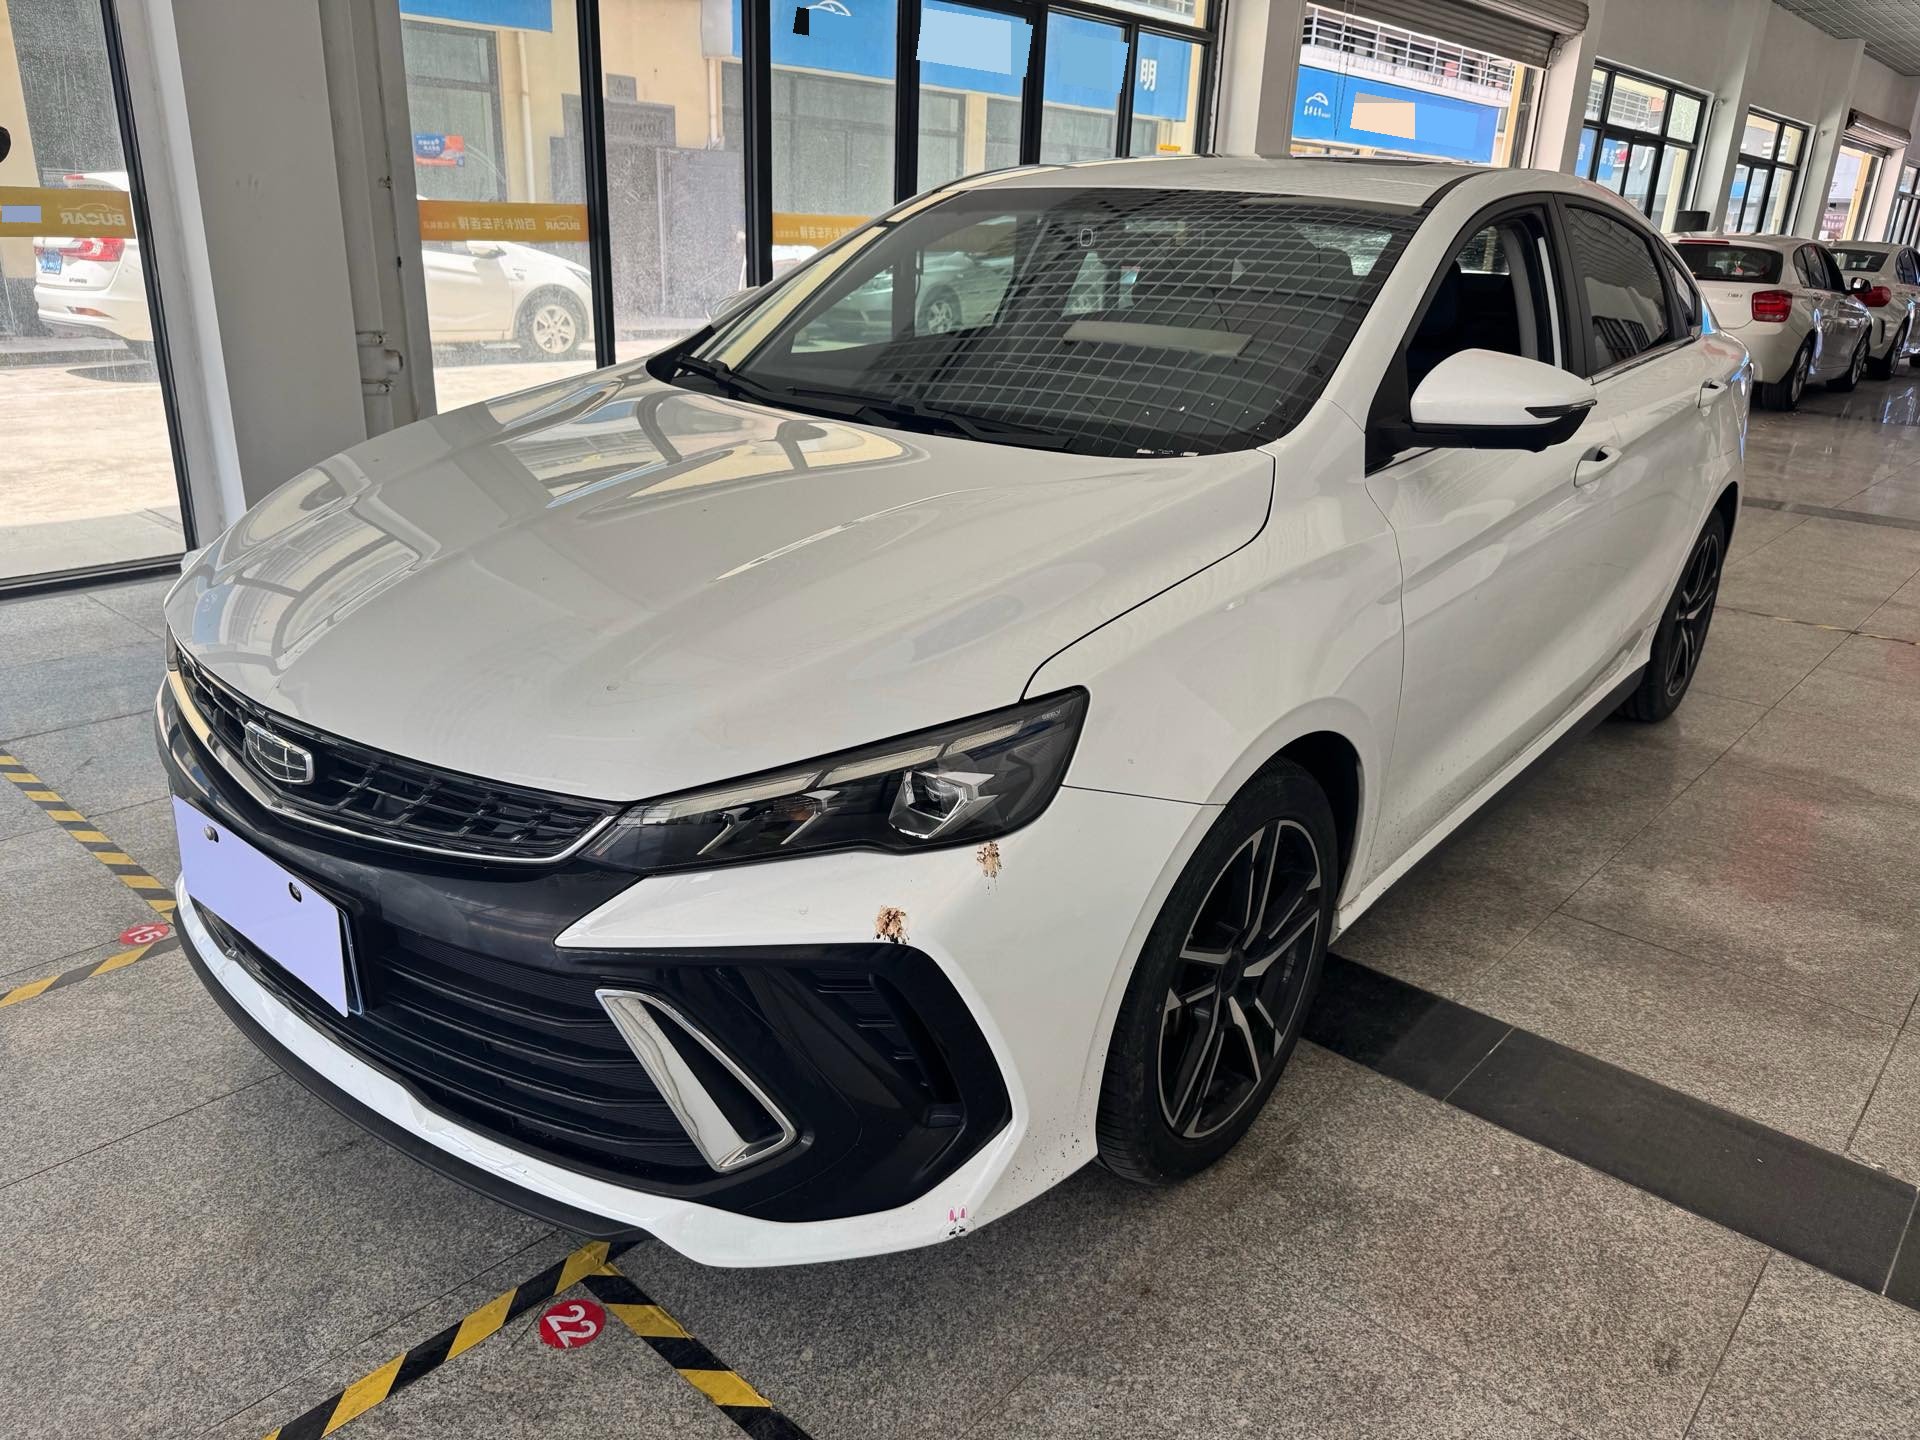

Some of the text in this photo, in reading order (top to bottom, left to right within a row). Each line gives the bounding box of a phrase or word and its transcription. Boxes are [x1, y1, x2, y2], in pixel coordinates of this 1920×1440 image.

[1140, 58, 1157, 91] 明
[127, 925, 164, 944] 15
[545, 1304, 597, 1348] 22
